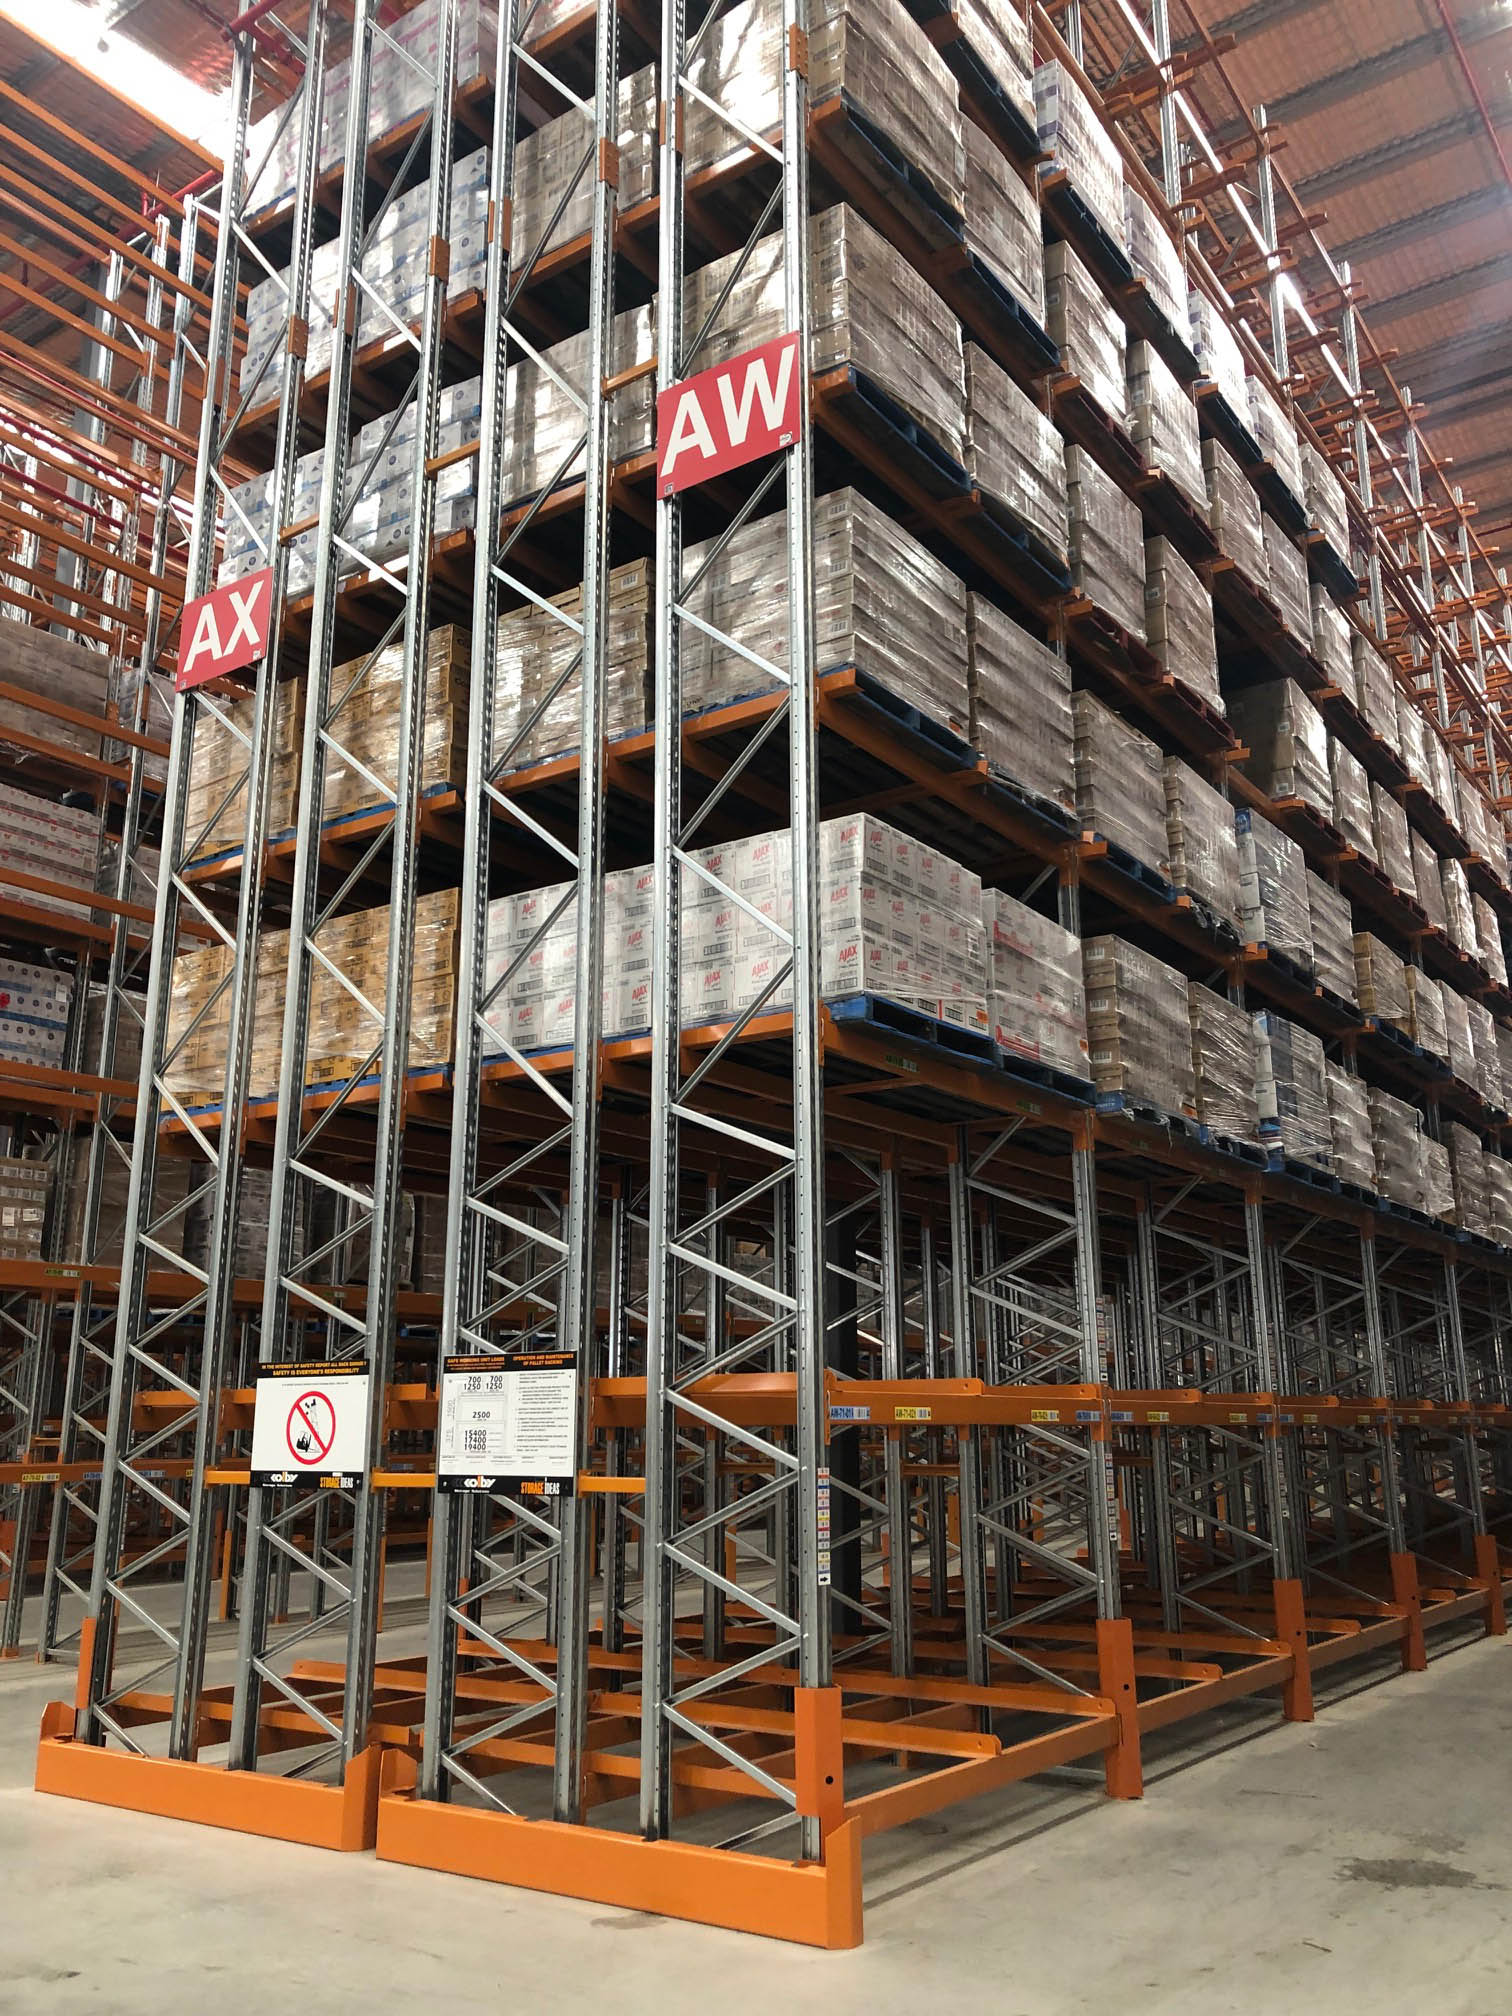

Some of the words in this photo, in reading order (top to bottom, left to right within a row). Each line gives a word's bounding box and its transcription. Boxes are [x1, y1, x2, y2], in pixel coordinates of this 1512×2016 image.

[660, 343, 796, 478] AW
[183, 579, 265, 673] AX
[840, 825, 858, 843] AJAX
[839, 945, 858, 963] AJAX
[752, 960, 769, 978] AJAX
[704, 970, 720, 987] AJAX
[632, 984, 648, 1000] AJAX
[518, 1007, 533, 1021] AJAX
[558, 1000, 574, 1013] AJAX
[320, 1476, 340, 1488] STORAGE
[520, 1481, 544, 1494] STORAGE
